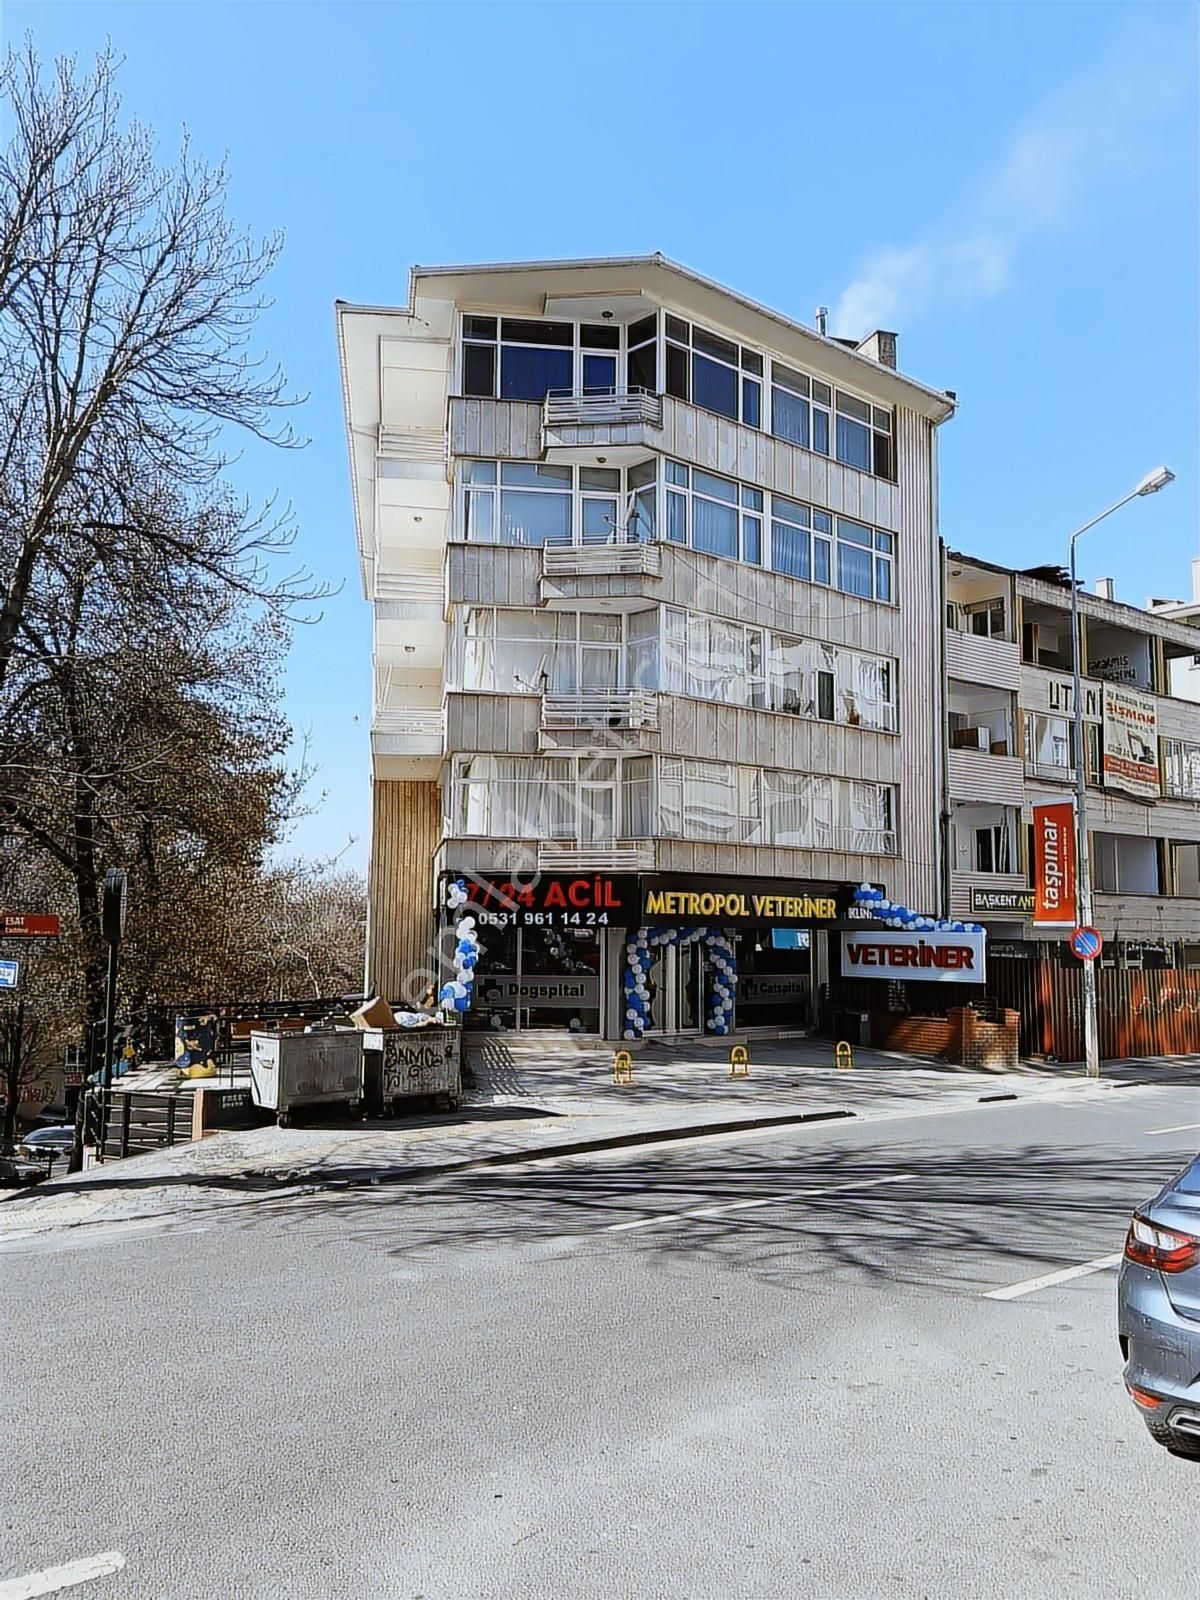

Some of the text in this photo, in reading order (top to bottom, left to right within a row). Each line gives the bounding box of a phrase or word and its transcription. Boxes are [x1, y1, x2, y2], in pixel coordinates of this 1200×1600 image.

[466, 876, 621, 908] 7/24 ACİL
[645, 890, 837, 918] METROPOL VETERİNER
[478, 912, 609, 925] 0531 961 14 24
[846, 939, 974, 969] VETERİNER
[508, 983, 585, 998] Dogspital
